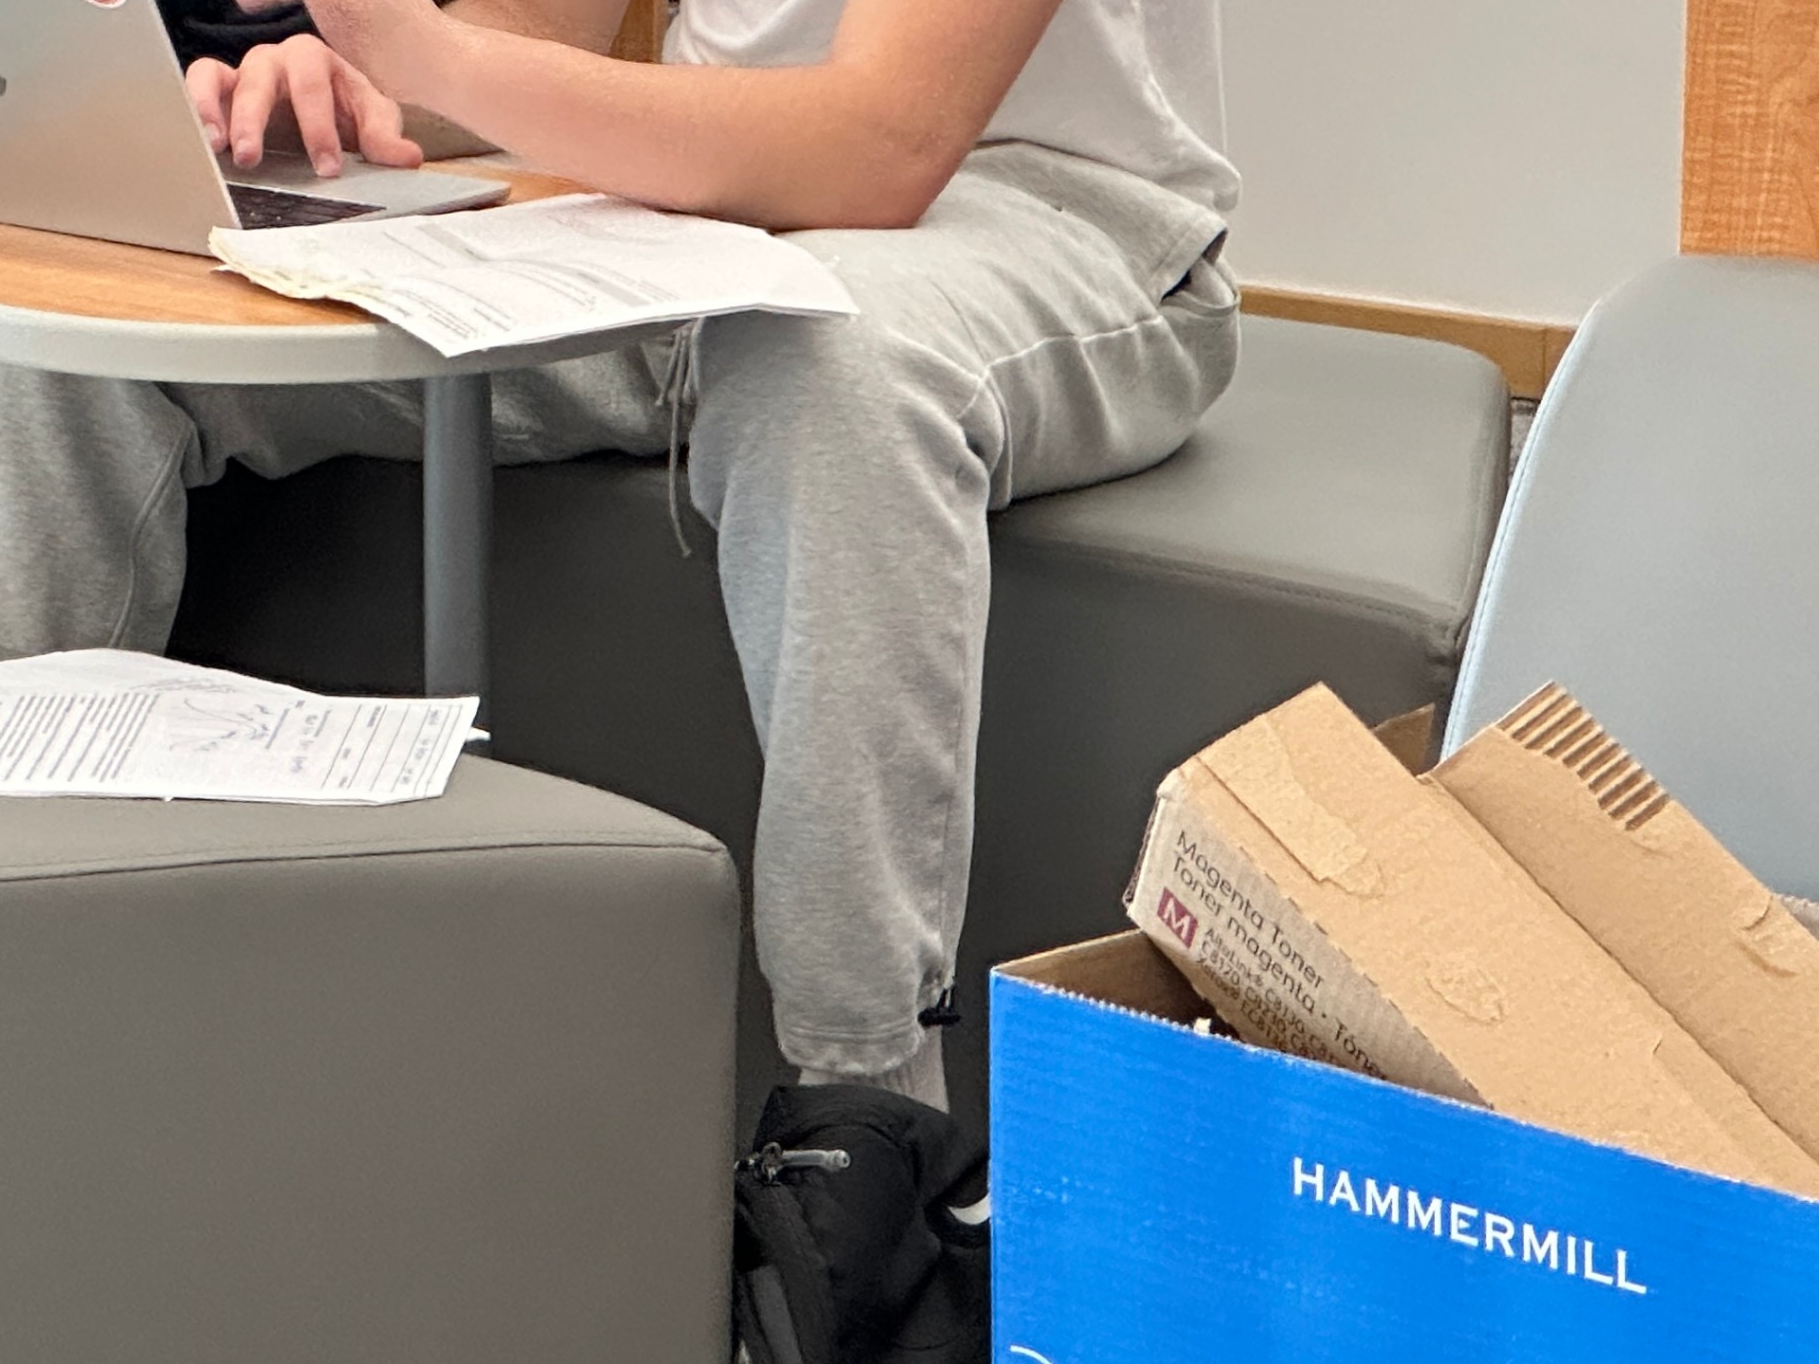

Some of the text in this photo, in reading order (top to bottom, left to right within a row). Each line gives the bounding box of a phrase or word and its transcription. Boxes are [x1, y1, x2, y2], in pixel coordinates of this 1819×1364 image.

[1163, 897, 1191, 941] M
[1173, 855, 1224, 917] Toner
[1227, 916, 1316, 1016] magenta
[1177, 831, 1325, 989] Magenta Toner
[1293, 1155, 1648, 1296] HAMMERMILL
